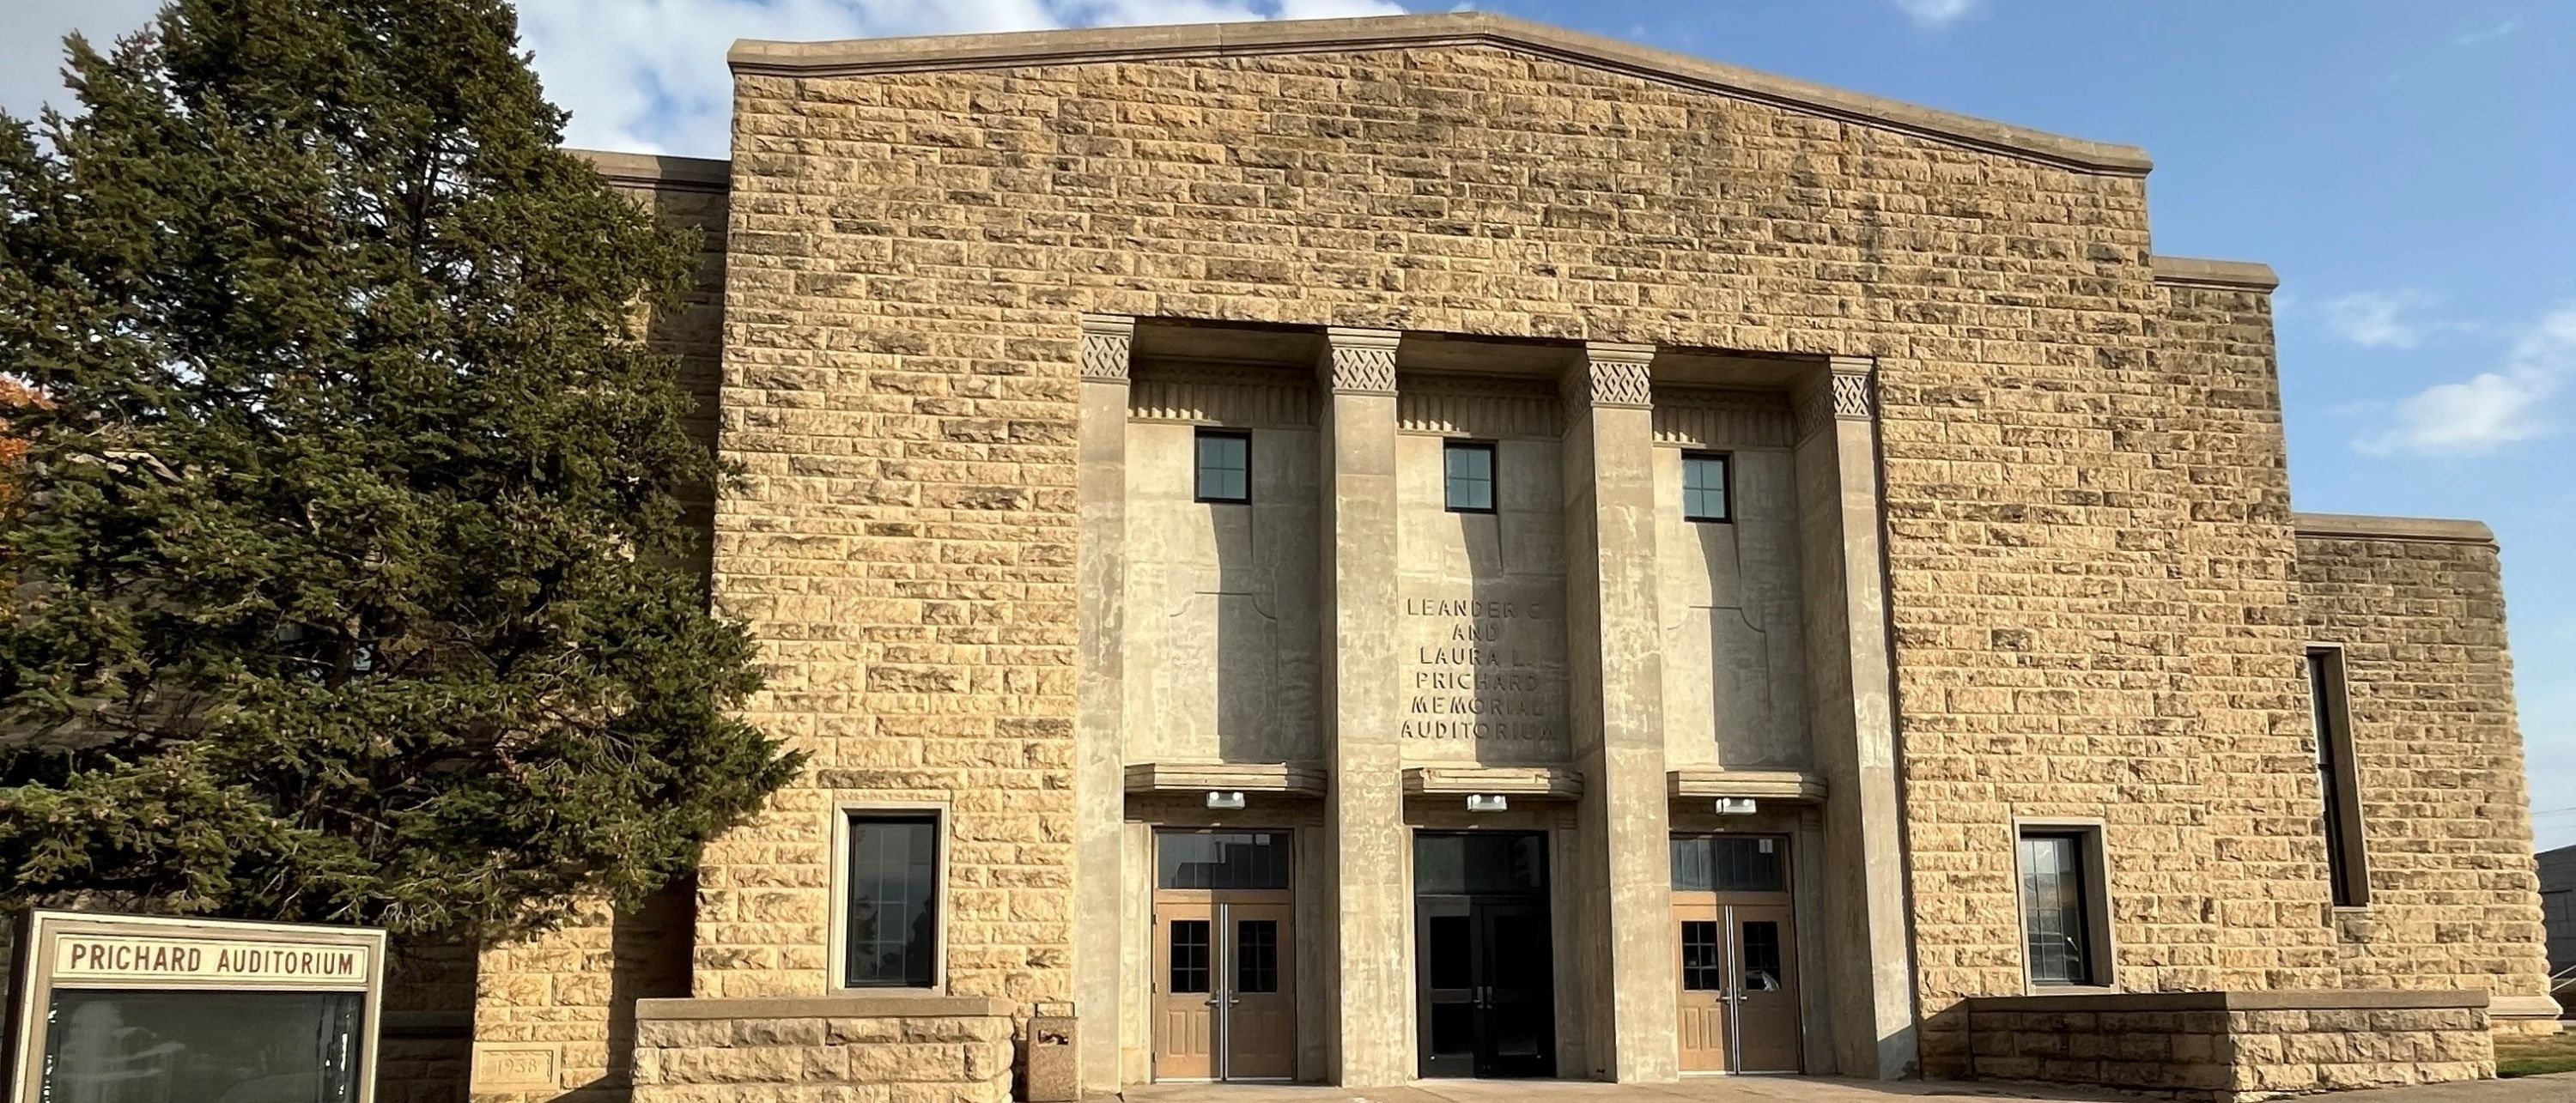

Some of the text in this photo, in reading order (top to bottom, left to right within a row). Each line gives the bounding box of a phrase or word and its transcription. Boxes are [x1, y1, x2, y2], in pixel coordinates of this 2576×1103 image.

[1407, 598, 1517, 618] LEANDER
[1452, 624, 1498, 642] AND
[1420, 646, 1500, 666] LAURA
[1417, 672, 1539, 691] PRICHARD
[1412, 696, 1545, 716] MEMORIAL
[1400, 720, 1555, 741] AUDITORIUM
[70, 942, 354, 976] PRICHARD AUDITORIUM
[497, 1058, 538, 1076] 1938
